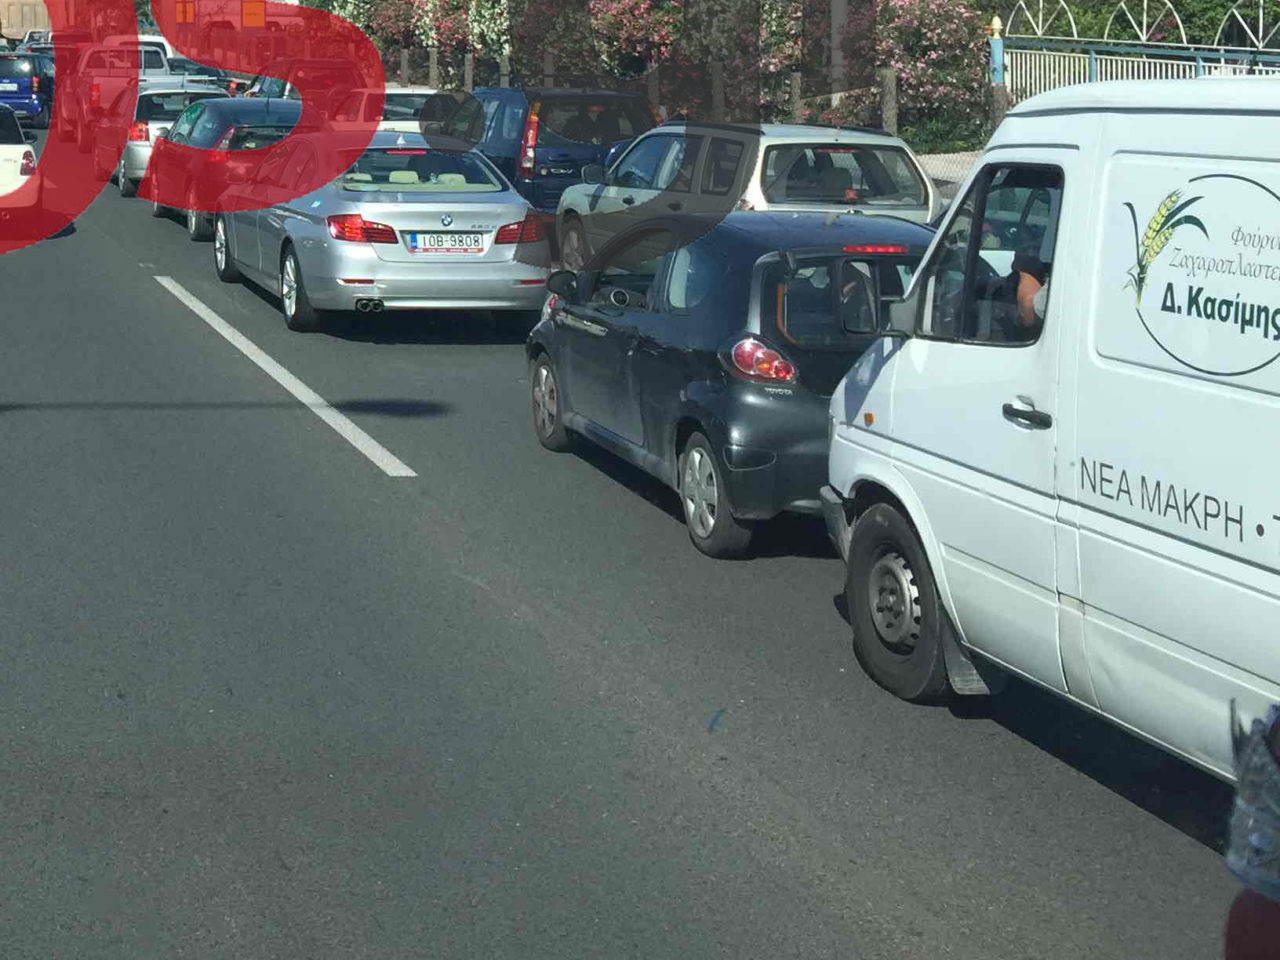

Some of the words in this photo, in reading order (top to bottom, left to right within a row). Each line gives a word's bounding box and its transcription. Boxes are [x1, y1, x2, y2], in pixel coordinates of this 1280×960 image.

[1169, 247, 1280, 282] Ζαχαροπλαστε
[1187, 285, 1280, 342] Κασίμης
[1081, 456, 1133, 507] ΝΕΑ
[1141, 475, 1243, 543] ΜΑΚΡΗ
